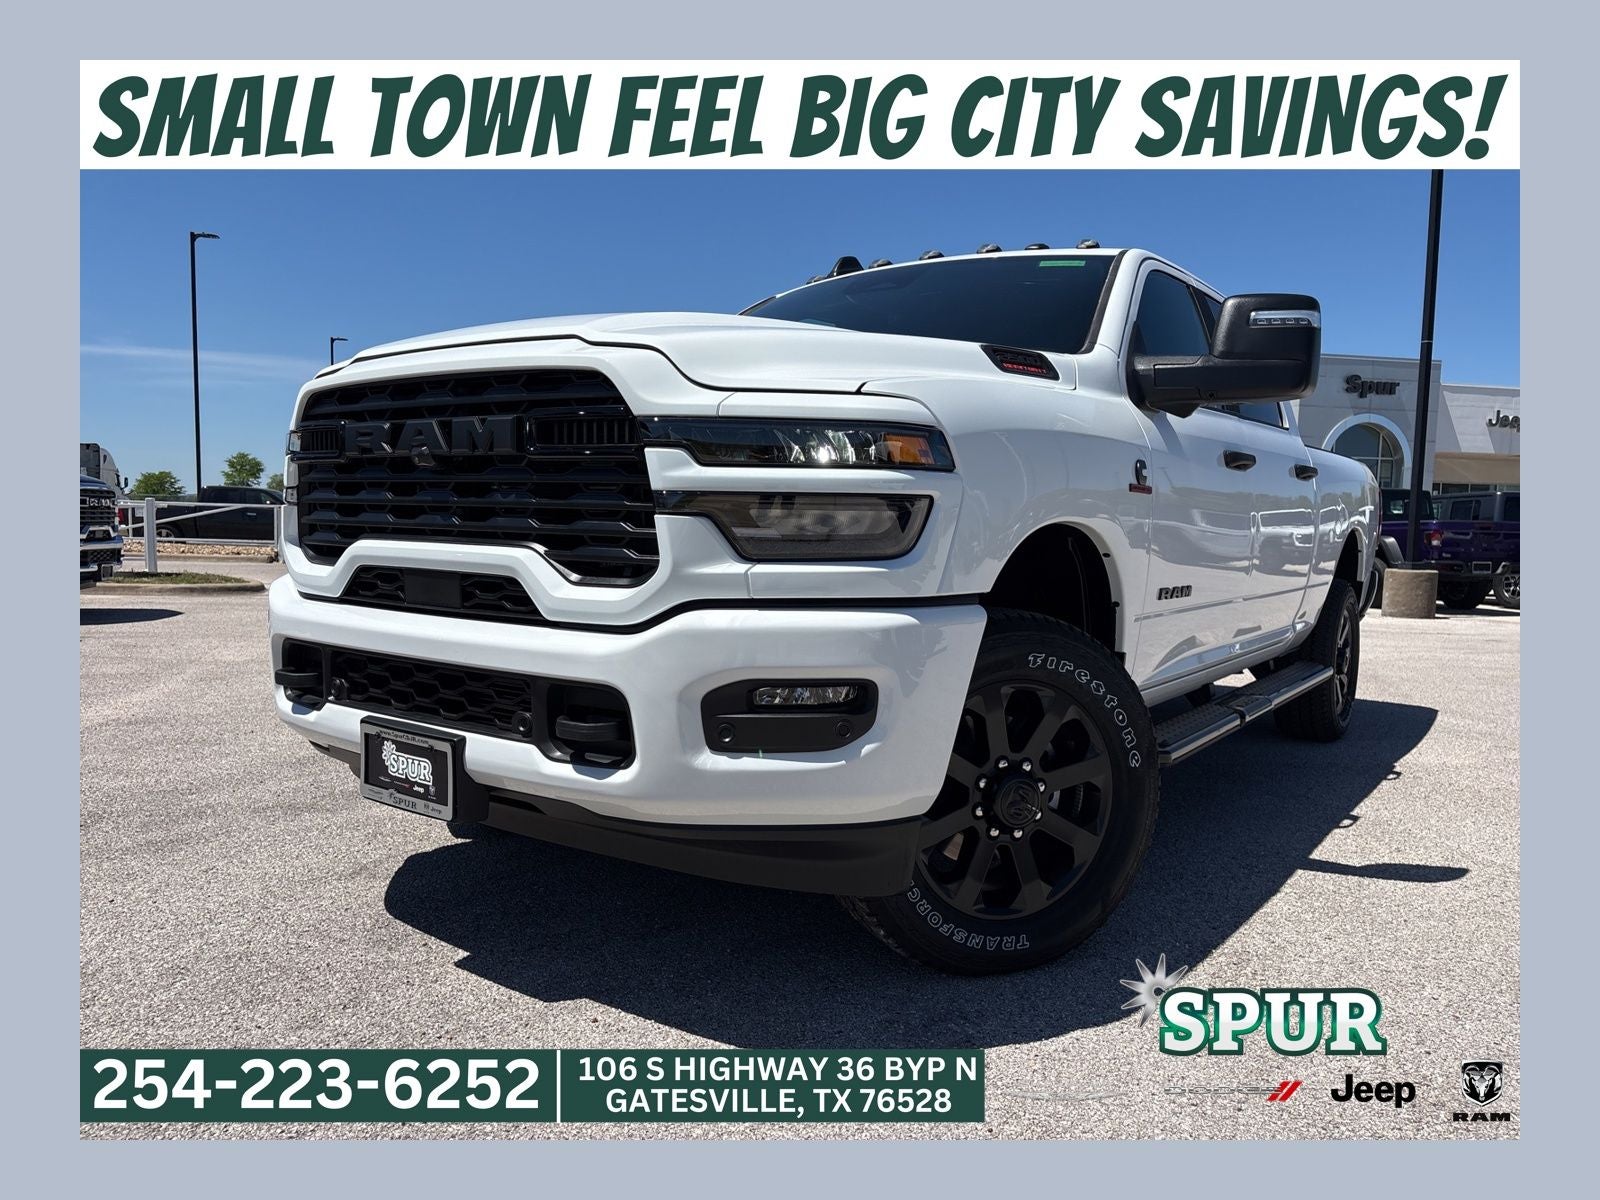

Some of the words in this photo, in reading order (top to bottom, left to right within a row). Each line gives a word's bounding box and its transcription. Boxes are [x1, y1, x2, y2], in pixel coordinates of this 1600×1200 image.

[1344, 374, 1399, 398] Spur
[345, 414, 520, 458] RAM
[1157, 585, 1193, 601] RAM
[1028, 653, 1141, 768] Firestone
[389, 752, 432, 785] SPUR
[393, 796, 417, 809] SPUR
[907, 879, 1030, 951] TRANSFORC
